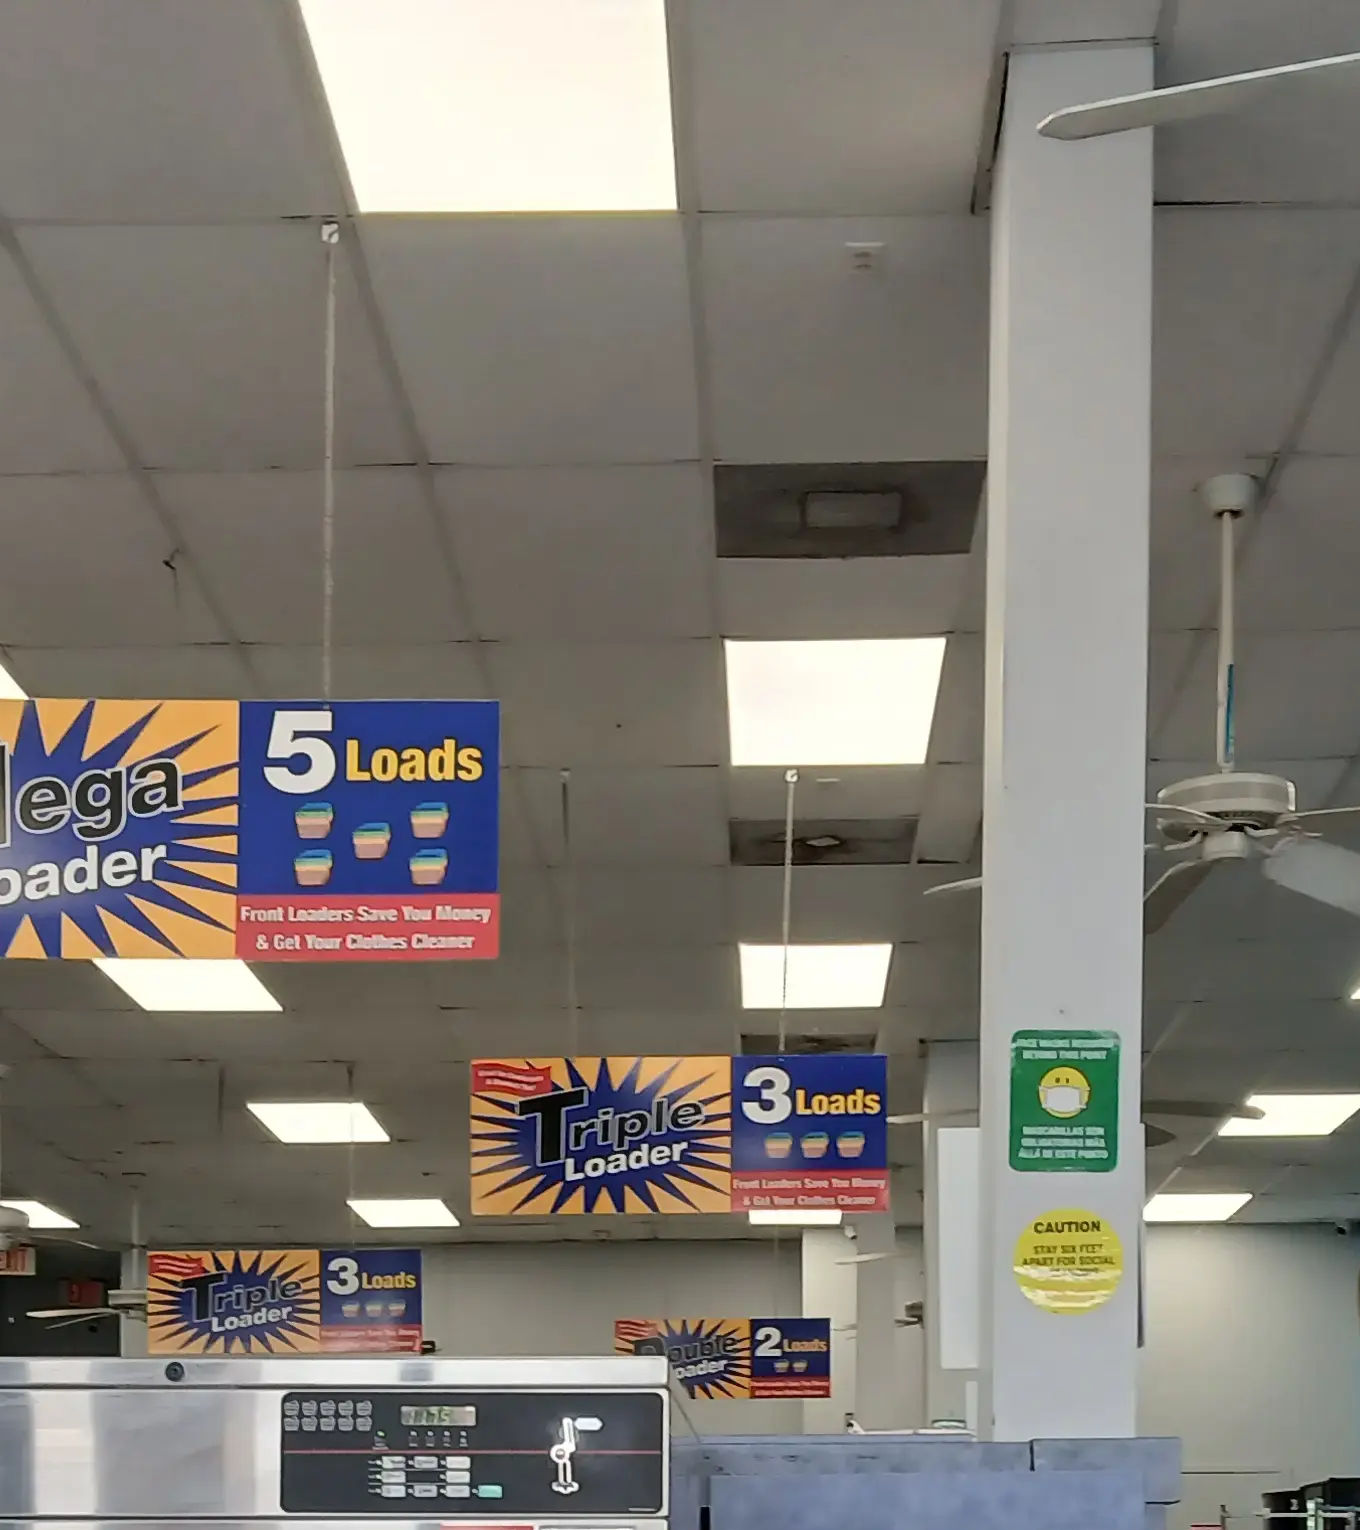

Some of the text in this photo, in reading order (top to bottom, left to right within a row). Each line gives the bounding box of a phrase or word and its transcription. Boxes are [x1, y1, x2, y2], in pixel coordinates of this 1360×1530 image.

[263, 710, 483, 794] 5 Loads
[240, 906, 492, 924] Front Loaders Save You Money
[256, 933, 476, 951] & Get Your Clothes Cleaner
[741, 1066, 881, 1124] 3 Loads
[517, 1087, 707, 1167] Triple
[564, 1140, 689, 1182] Loader
[1033, 1221, 1101, 1233] CAUTION
[1022, 1257, 1054, 1266] APART
[1056, 1257, 1076, 1265] FOR
[1033, 1245, 1058, 1254] STAY
[327, 1257, 417, 1295] 3 Loads
[180, 1272, 304, 1323] Triple
[211, 1305, 292, 1332] Loader
[754, 1327, 828, 1357] 2 Loads
[674, 1359, 729, 1379] oader
